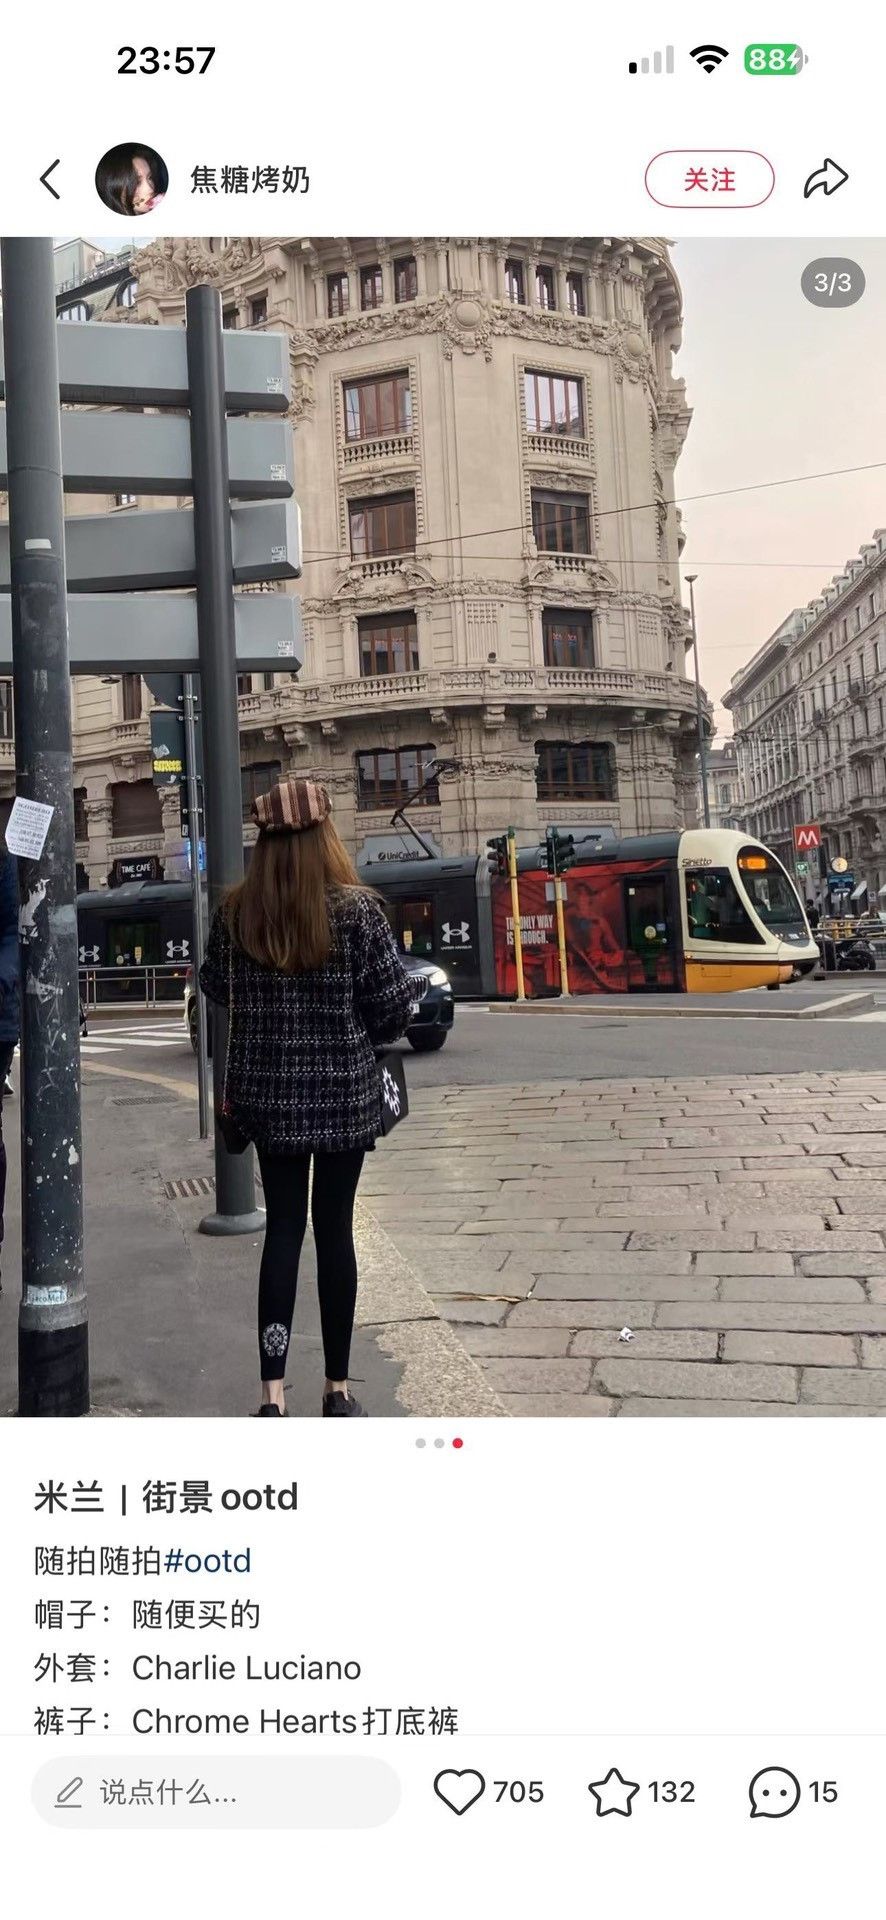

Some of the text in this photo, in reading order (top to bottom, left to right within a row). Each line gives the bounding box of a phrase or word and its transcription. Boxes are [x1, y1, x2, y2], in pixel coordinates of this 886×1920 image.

[797, 830, 818, 846] M
[121, 865, 135, 873] TIME
[536, 914, 554, 928] WAY
[506, 931, 515, 945] IS
